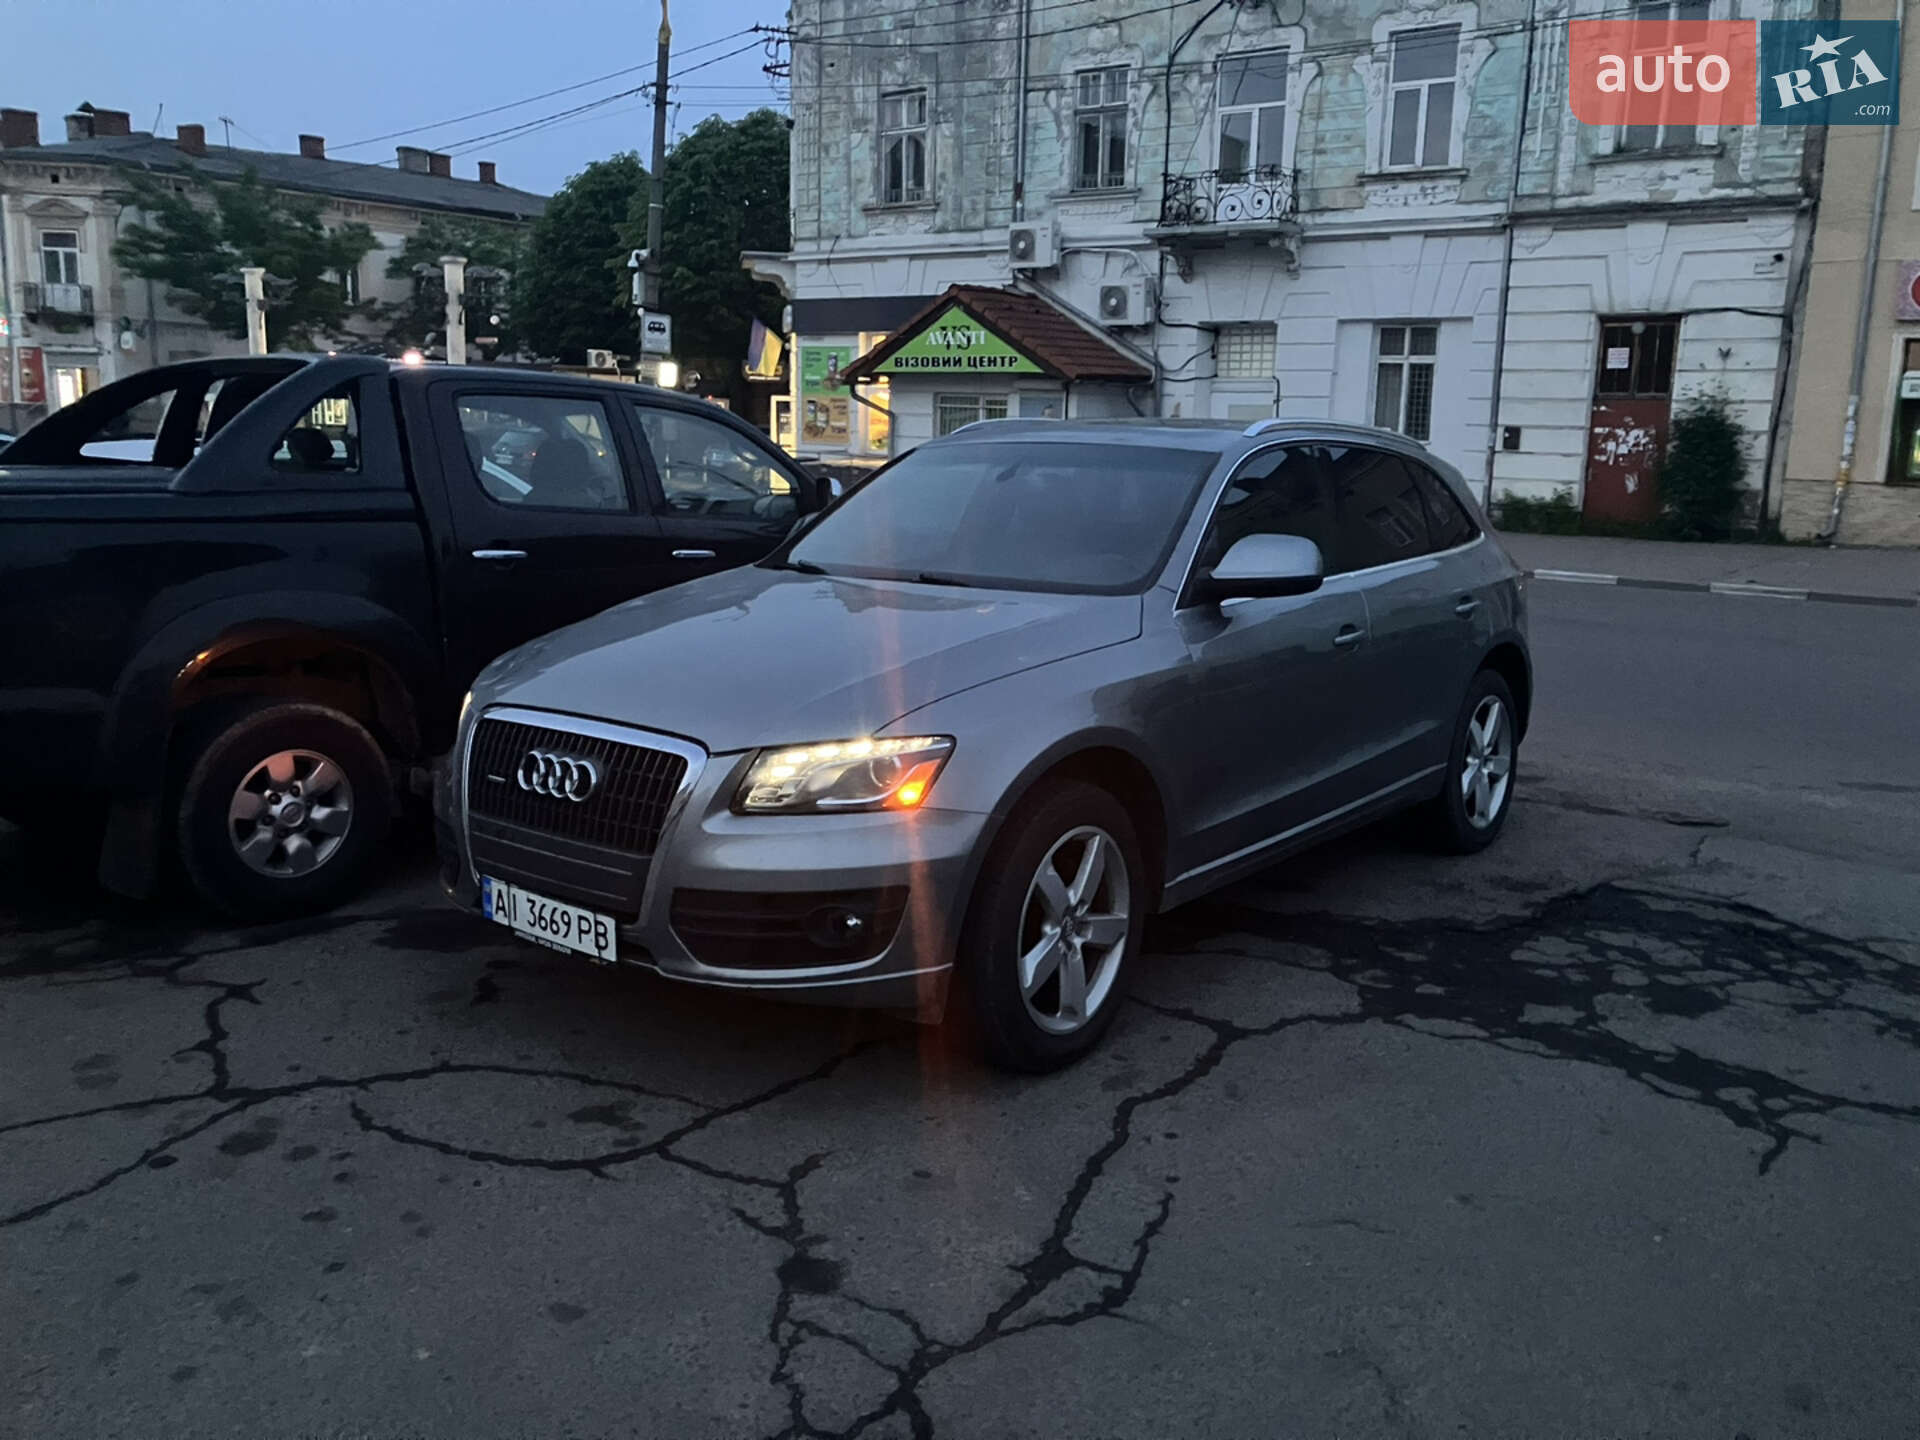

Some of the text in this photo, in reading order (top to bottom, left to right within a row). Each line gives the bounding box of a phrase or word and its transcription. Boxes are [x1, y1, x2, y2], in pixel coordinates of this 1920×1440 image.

[926, 331, 985, 345] AVANTI
[967, 356, 1018, 369] ЦЕНТР
[527, 898, 572, 939] 3669
